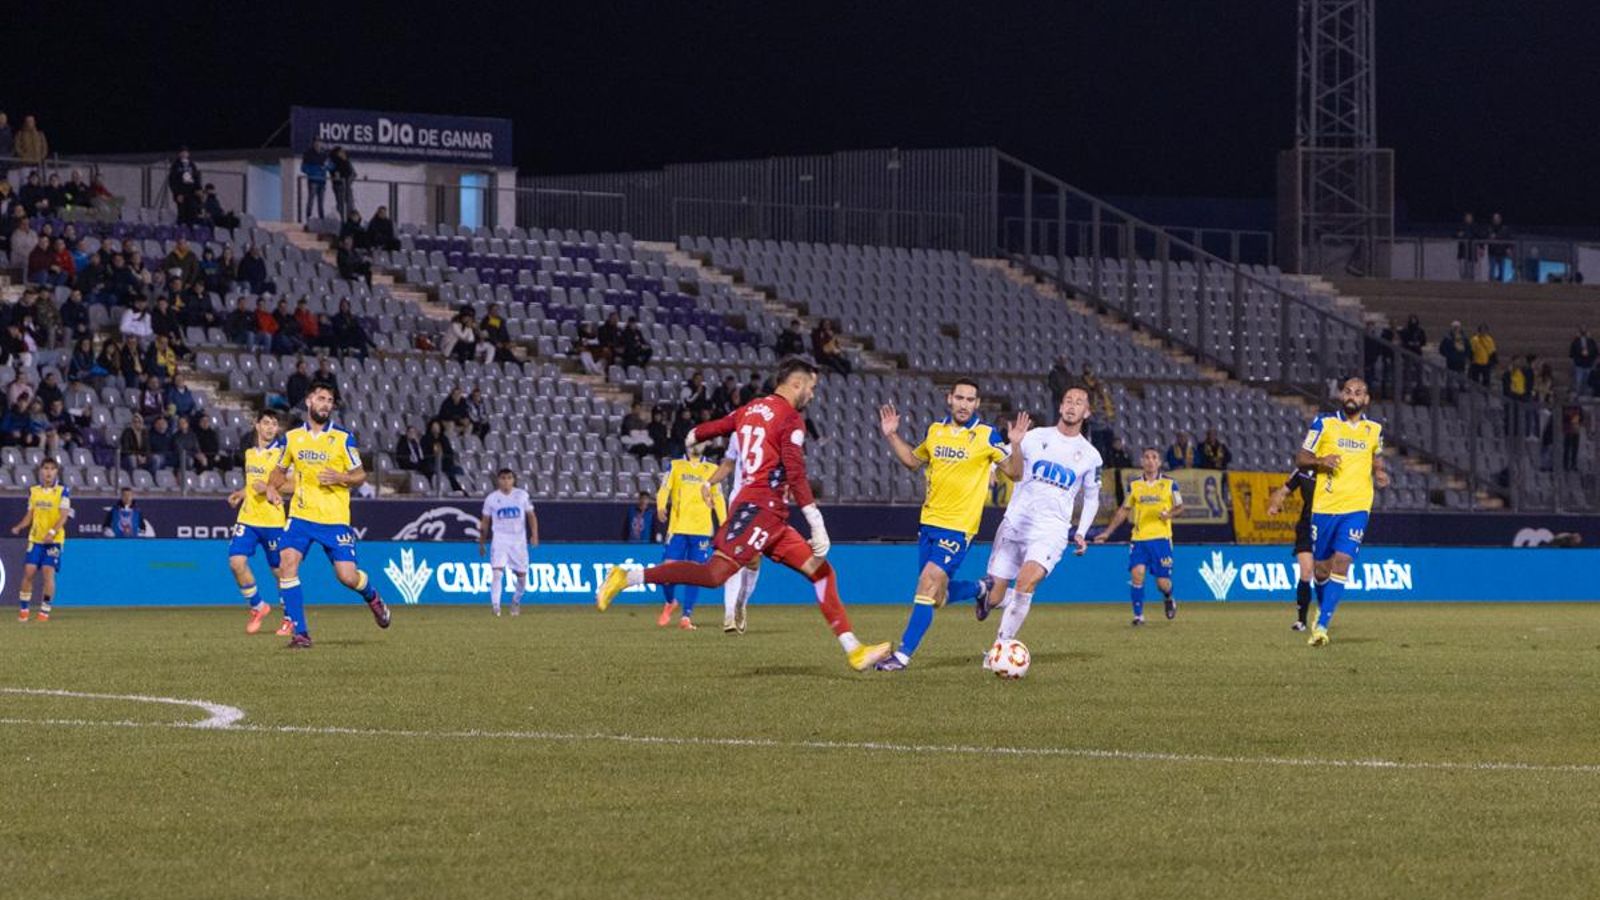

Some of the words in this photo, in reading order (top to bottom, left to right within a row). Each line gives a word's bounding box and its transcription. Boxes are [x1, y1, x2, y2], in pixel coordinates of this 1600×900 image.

[319, 122, 350, 141] HOY
[353, 125, 373, 142] ES
[418, 128, 438, 146] DE
[441, 131, 493, 149] GANAR
[740, 424, 766, 475] 13
[747, 526, 769, 550] 13
[436, 562, 494, 595] CAJA
[1240, 562, 1293, 591] CAJA
[1362, 558, 1413, 591] JAÉN
